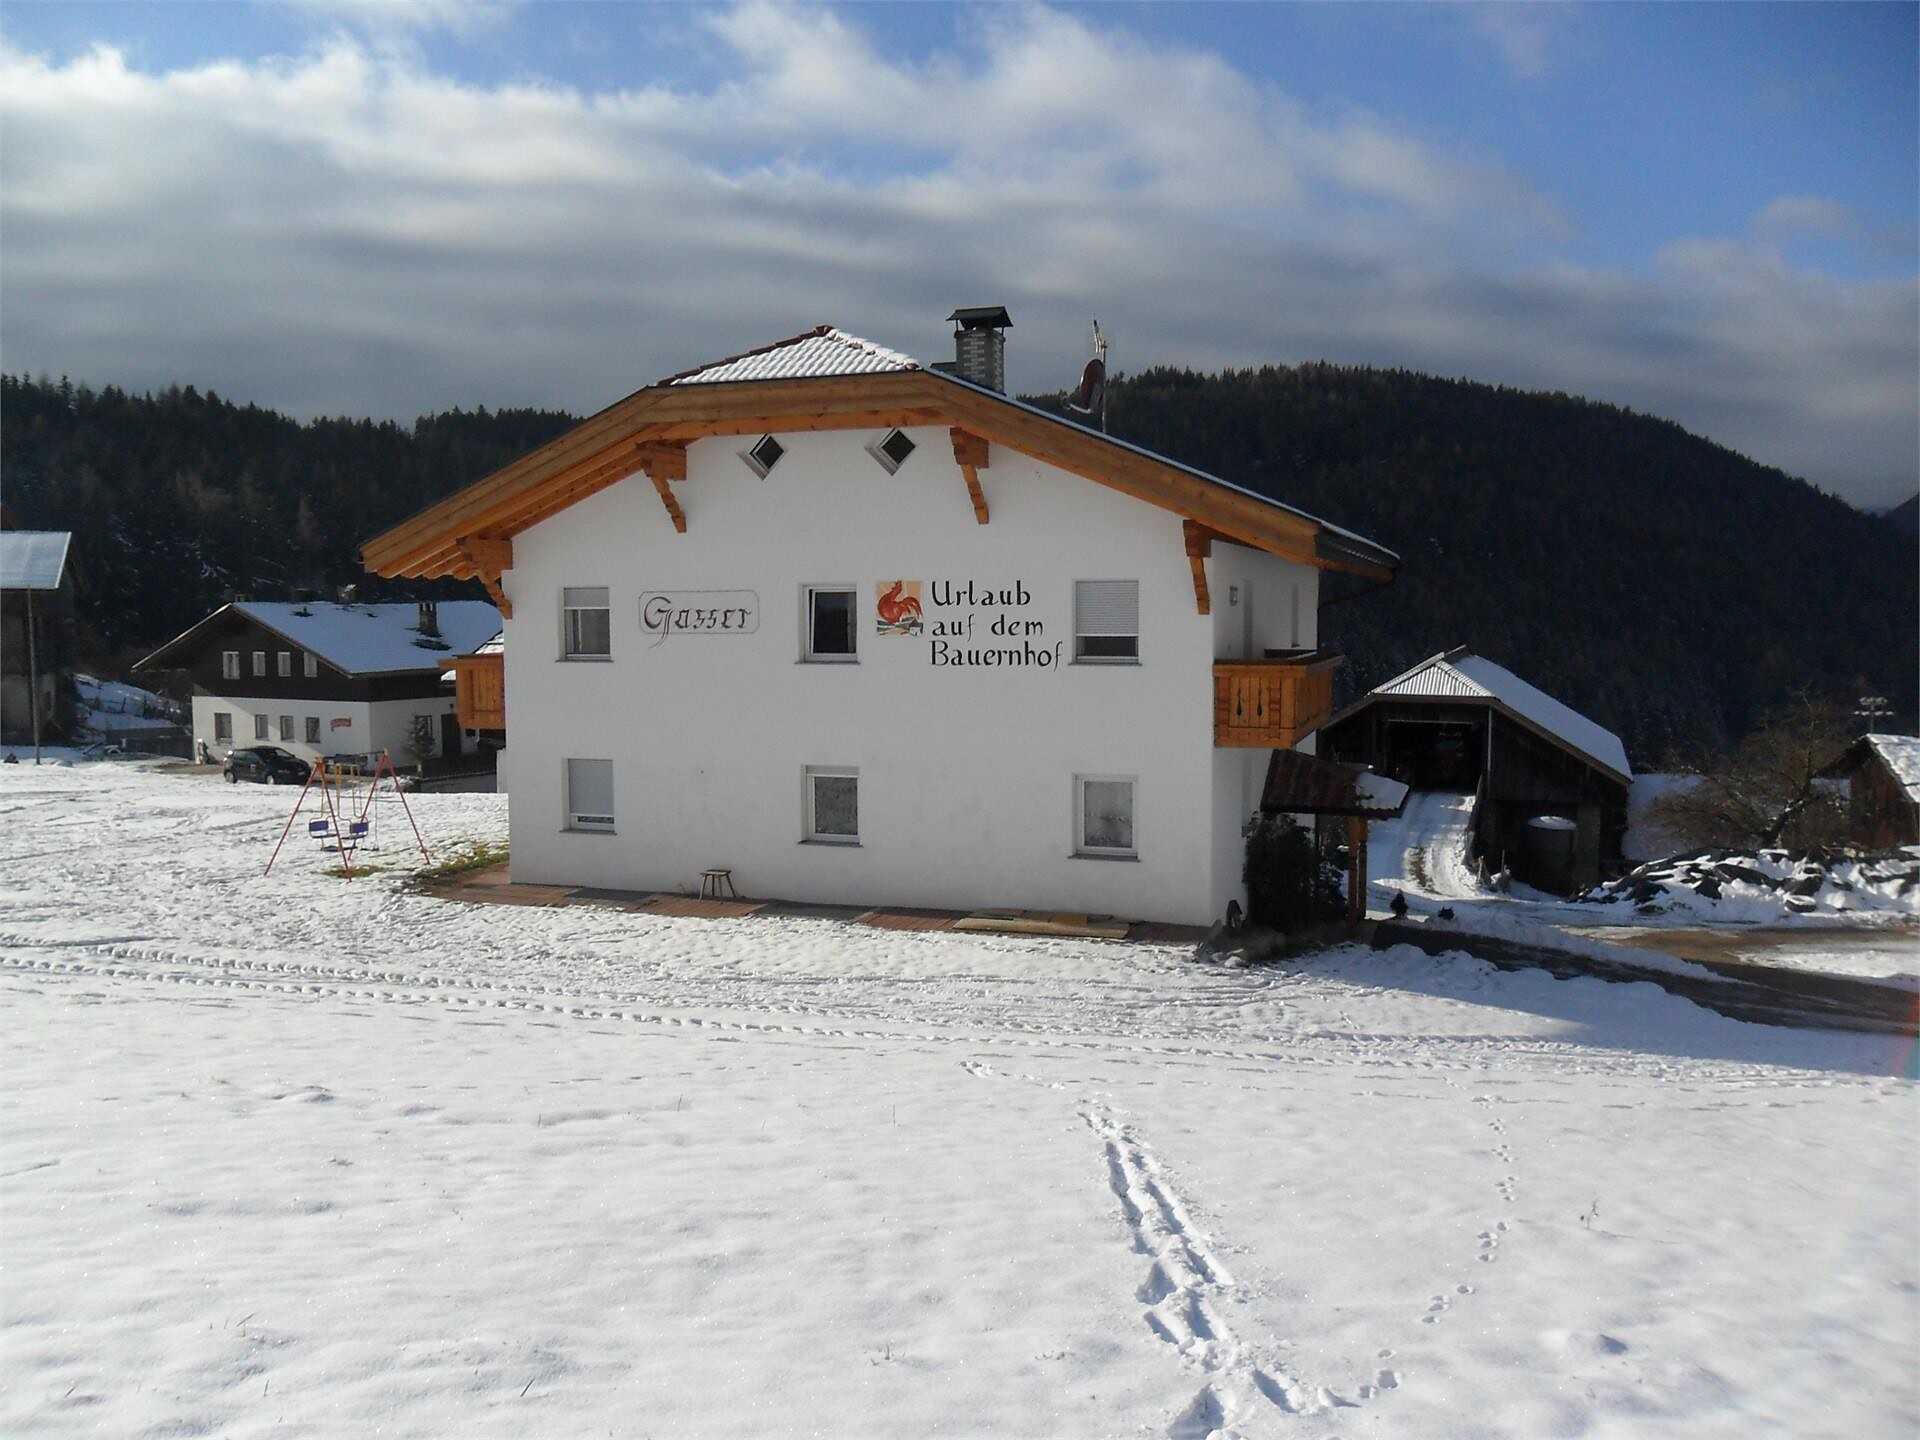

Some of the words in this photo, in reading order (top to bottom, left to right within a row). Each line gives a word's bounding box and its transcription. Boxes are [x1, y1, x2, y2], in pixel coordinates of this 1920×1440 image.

[931, 579, 1032, 607] Urlaub
[643, 595, 752, 649] Gasser
[931, 613, 975, 642] auf
[990, 613, 1044, 637] dem
[929, 639, 1063, 672] Bauernhof
